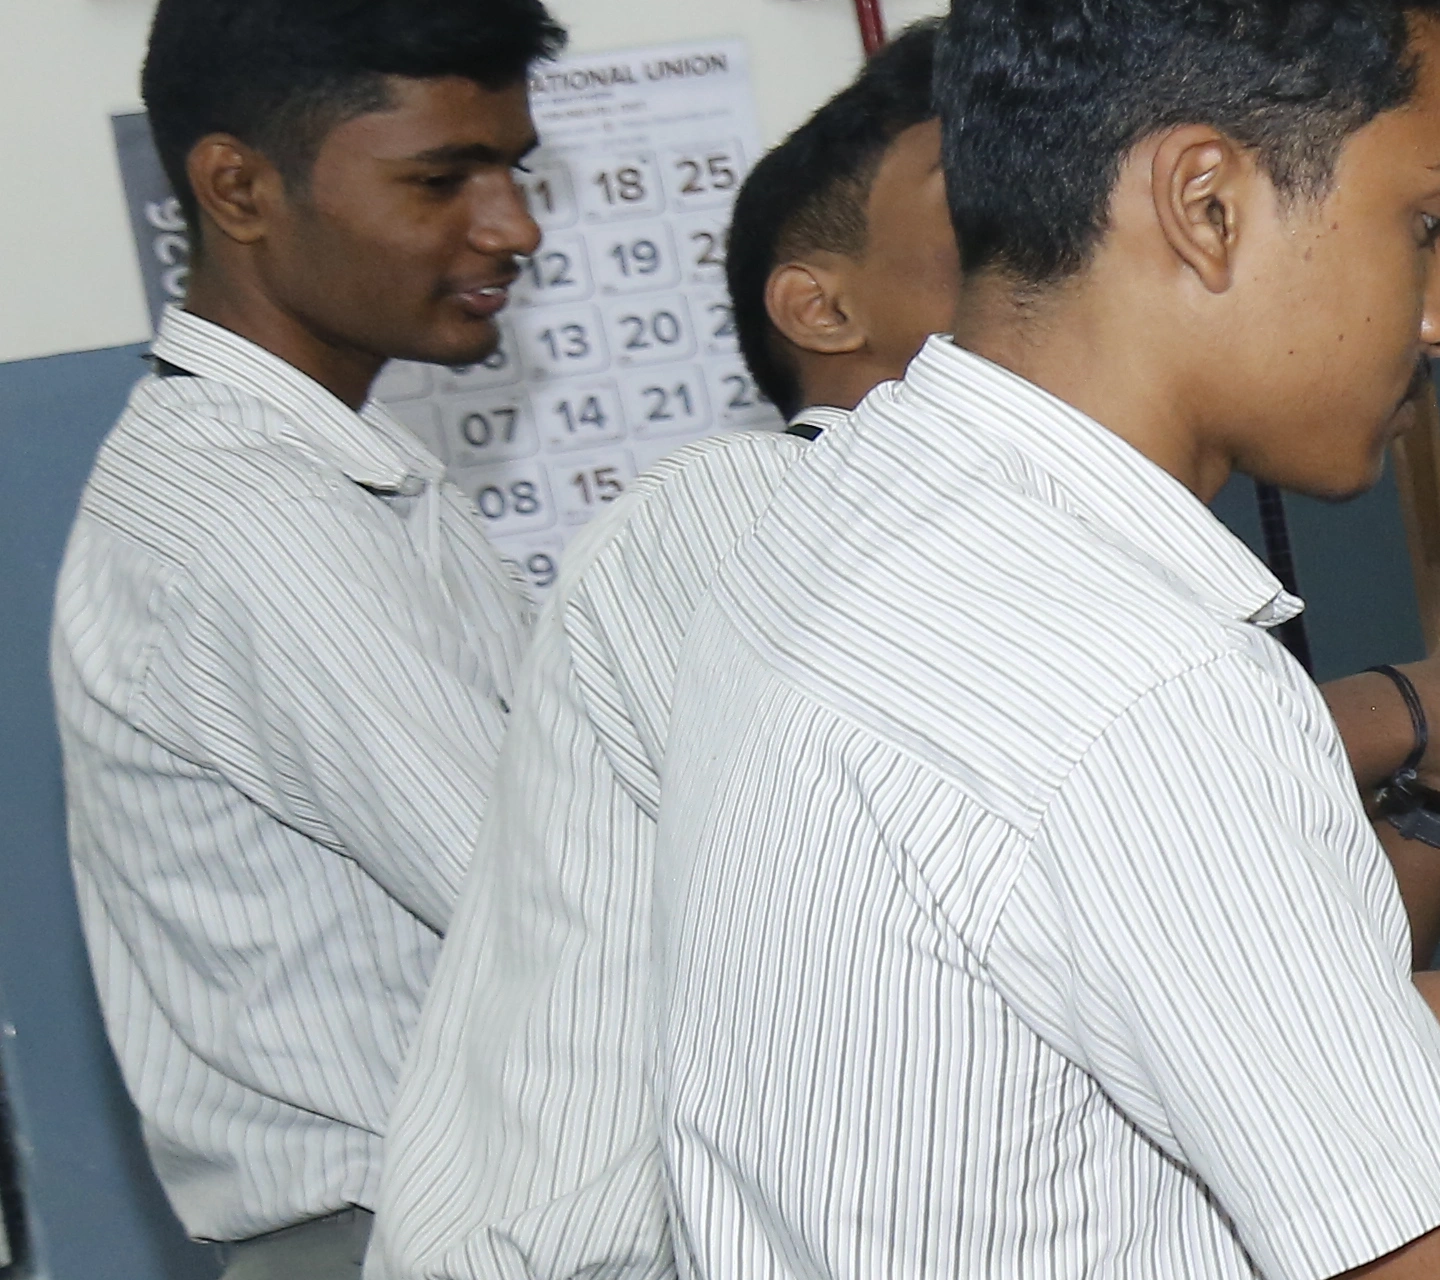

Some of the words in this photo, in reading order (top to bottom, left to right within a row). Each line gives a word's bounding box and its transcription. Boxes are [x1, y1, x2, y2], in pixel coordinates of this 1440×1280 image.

[643, 53, 729, 81] UNION
[595, 167, 647, 206] 18
[675, 156, 735, 194] 25
[525, 252, 575, 290] 12
[610, 239, 660, 277] 19
[538, 324, 590, 360] 13
[619, 310, 681, 350] 20
[555, 395, 607, 434] 14
[641, 383, 695, 421] 21
[461, 408, 517, 448] 07
[478, 480, 540, 519] 08
[571, 467, 624, 506] 15
